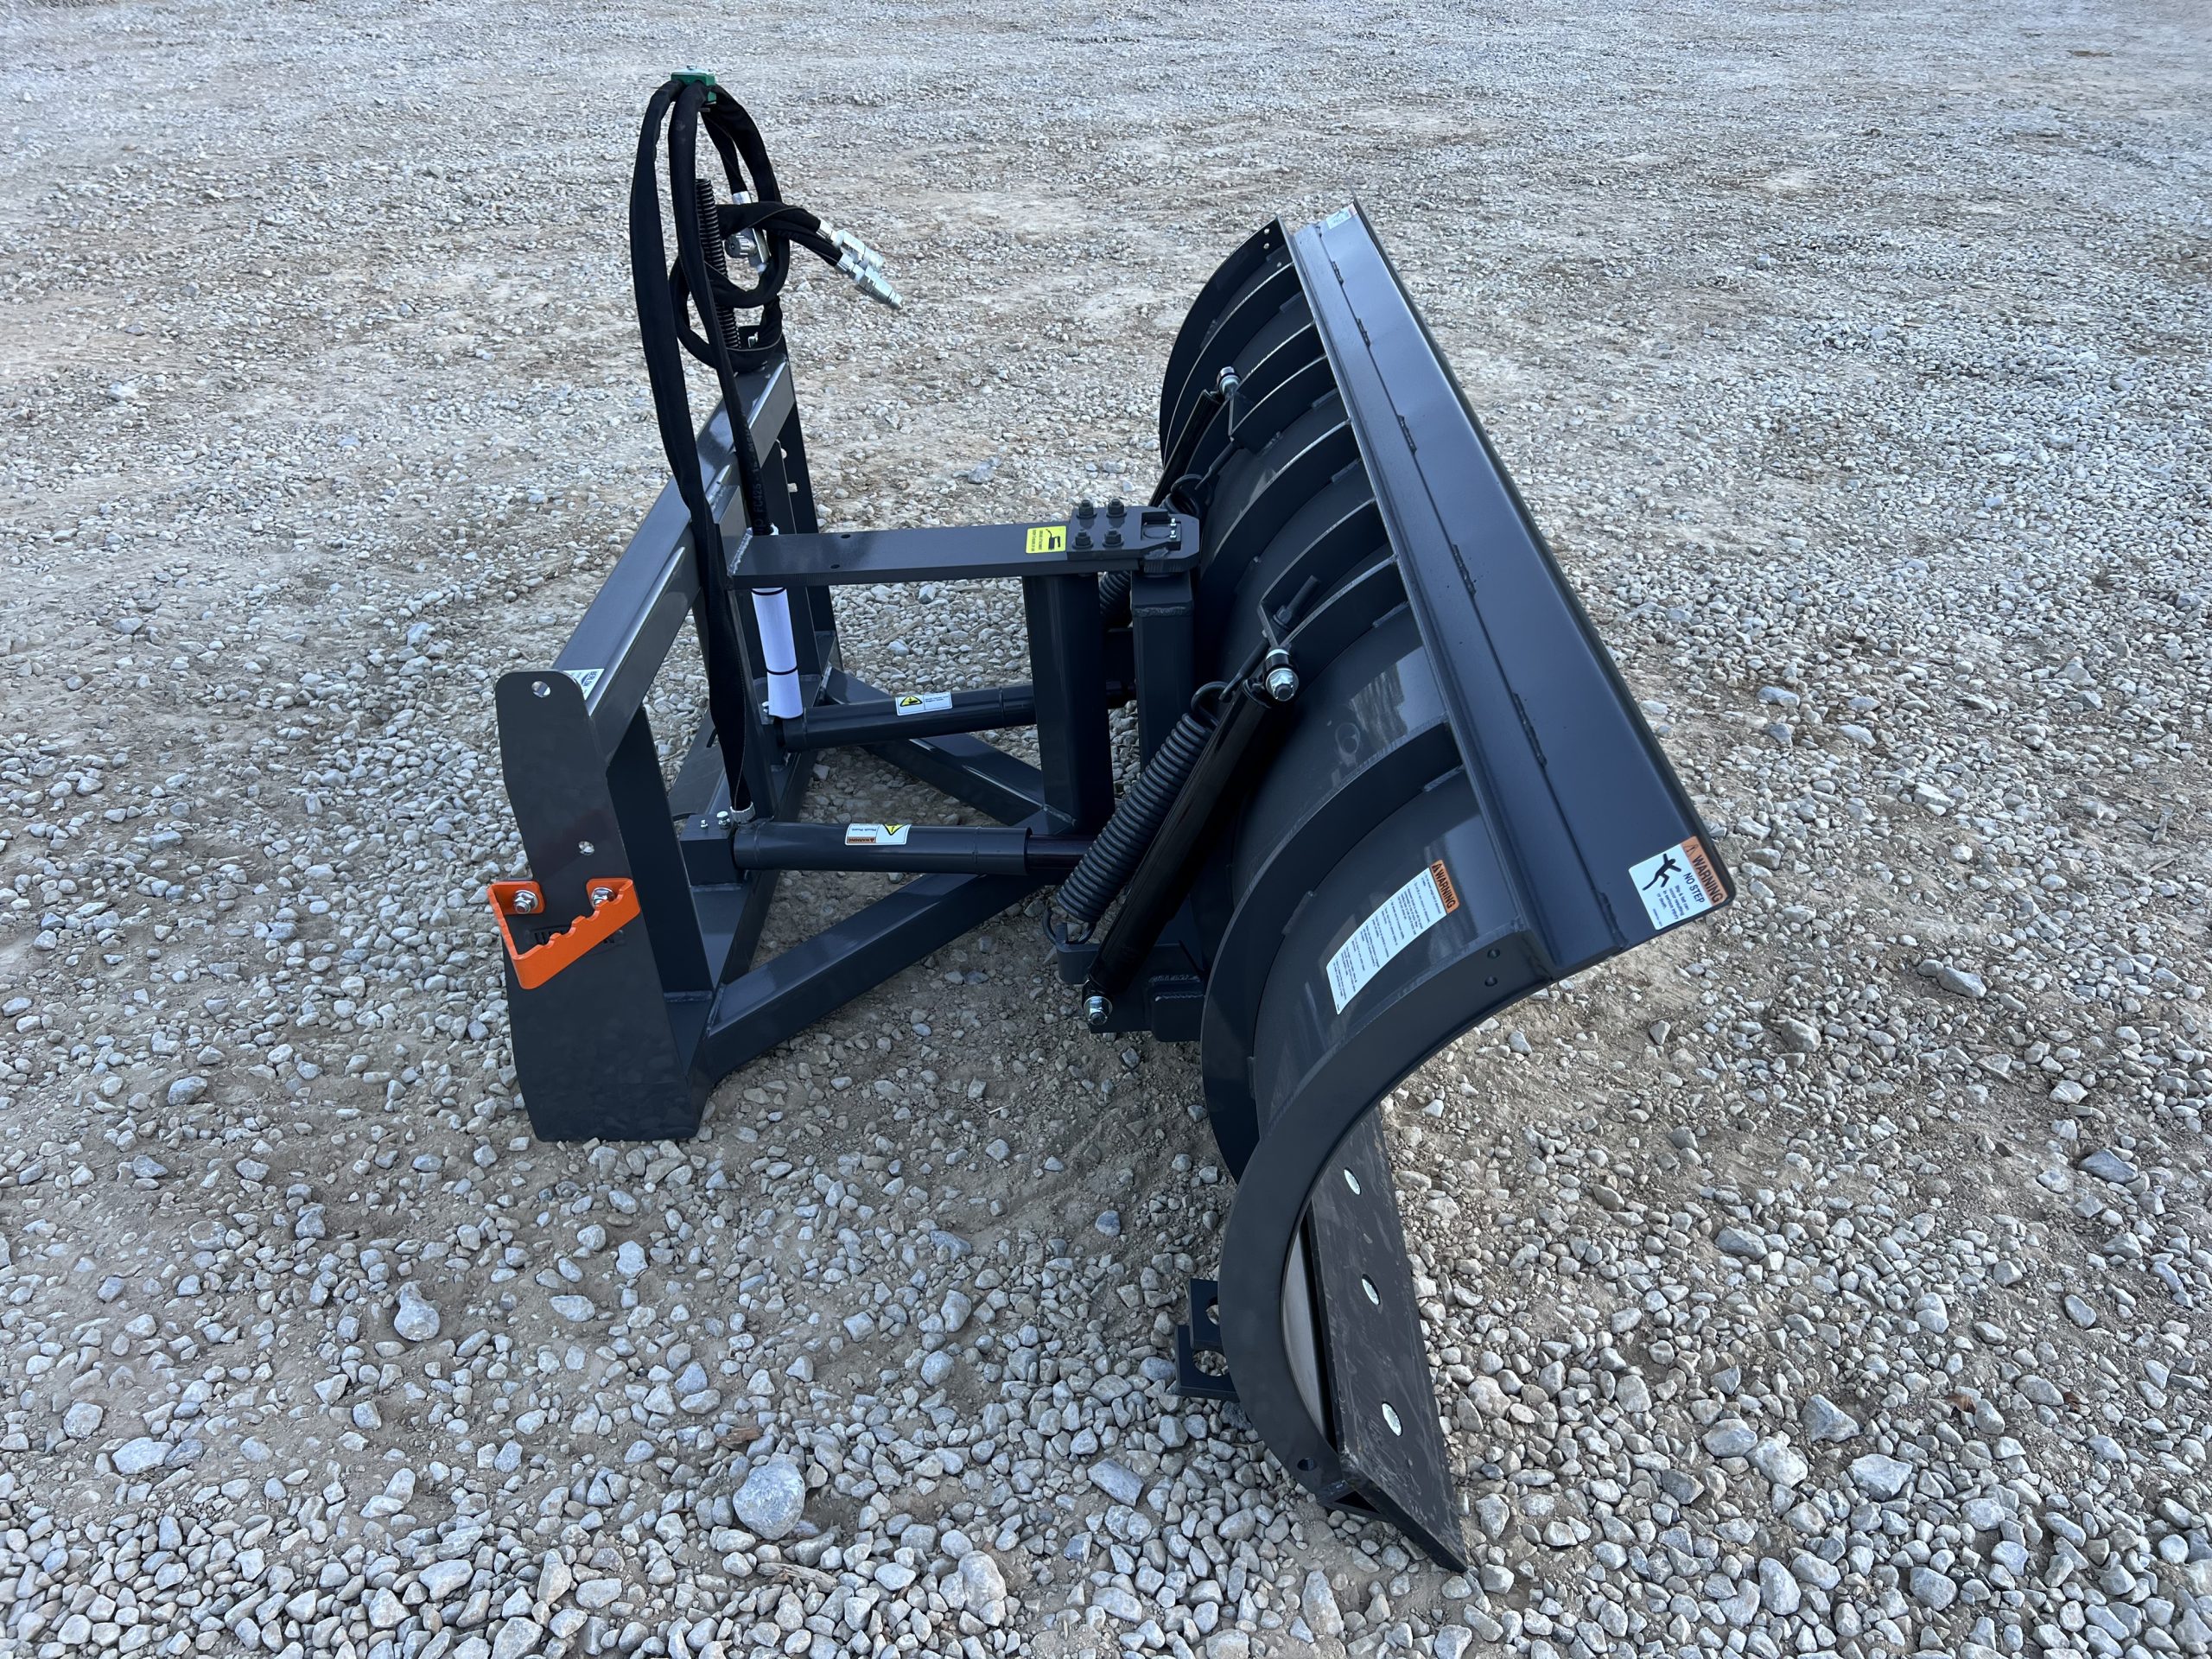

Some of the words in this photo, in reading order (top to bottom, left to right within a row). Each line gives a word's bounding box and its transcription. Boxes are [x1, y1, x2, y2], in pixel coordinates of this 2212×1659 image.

[1434, 868, 1456, 909] WARNING
[1683, 872, 1694, 885] NO
[1689, 884, 1705, 904] STEP
[1691, 855, 1723, 903] WARNING
